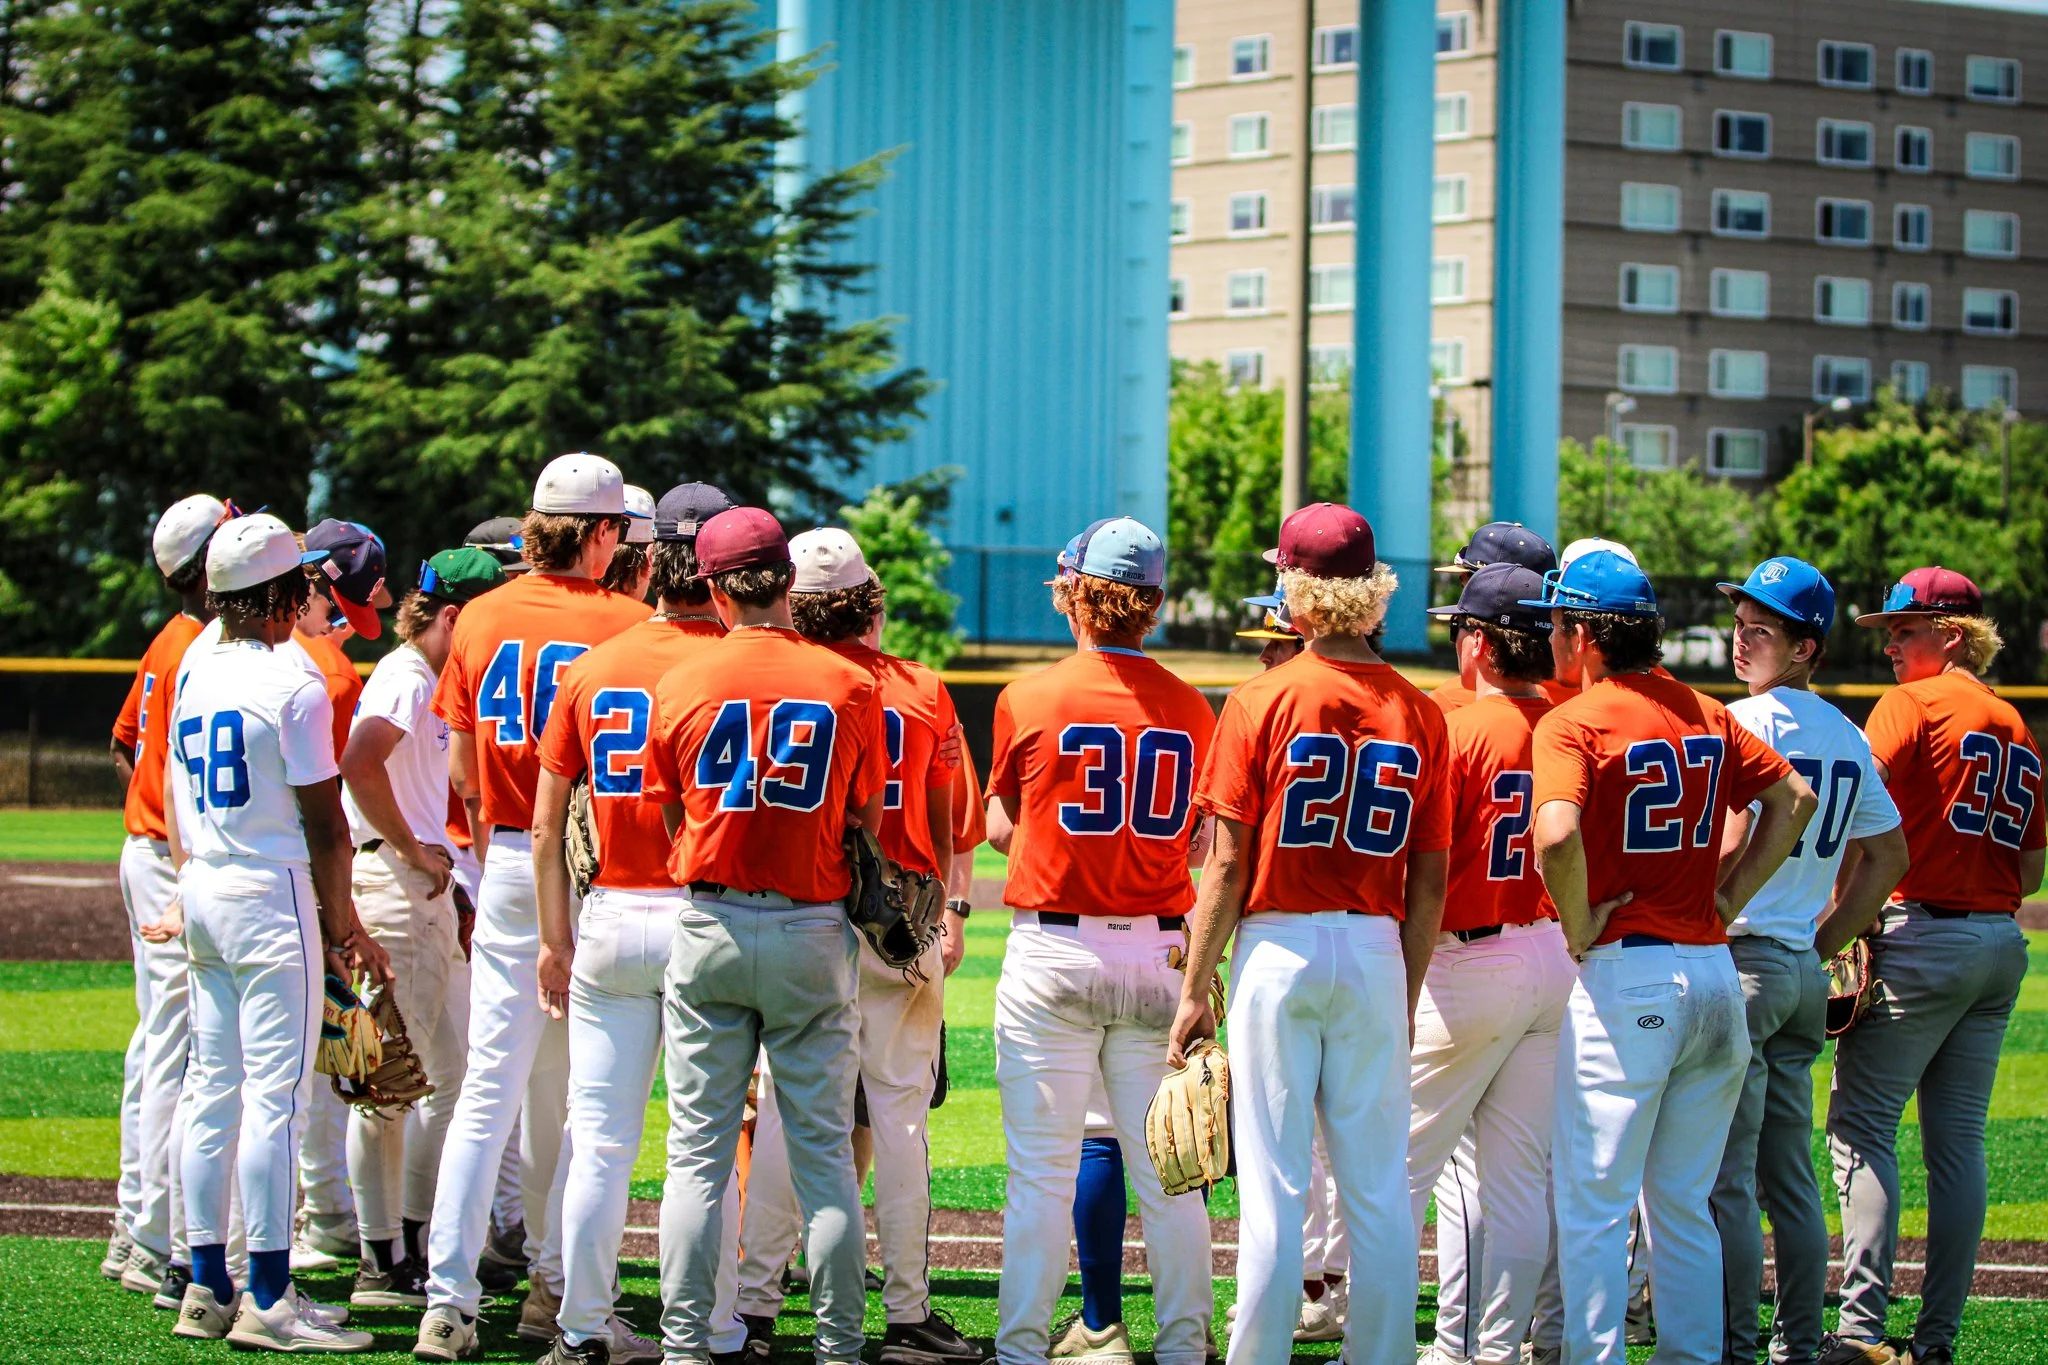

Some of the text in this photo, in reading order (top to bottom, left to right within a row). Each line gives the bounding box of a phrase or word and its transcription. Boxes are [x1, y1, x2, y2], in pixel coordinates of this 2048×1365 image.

[1111, 568, 1146, 581] WARRIORS
[696, 698, 837, 813] 49
[1058, 723, 1194, 839] 30
[1278, 732, 1422, 857] 26
[1623, 735, 1724, 853] 27
[1949, 730, 2041, 851] 35
[1107, 922, 1132, 931] marucci
